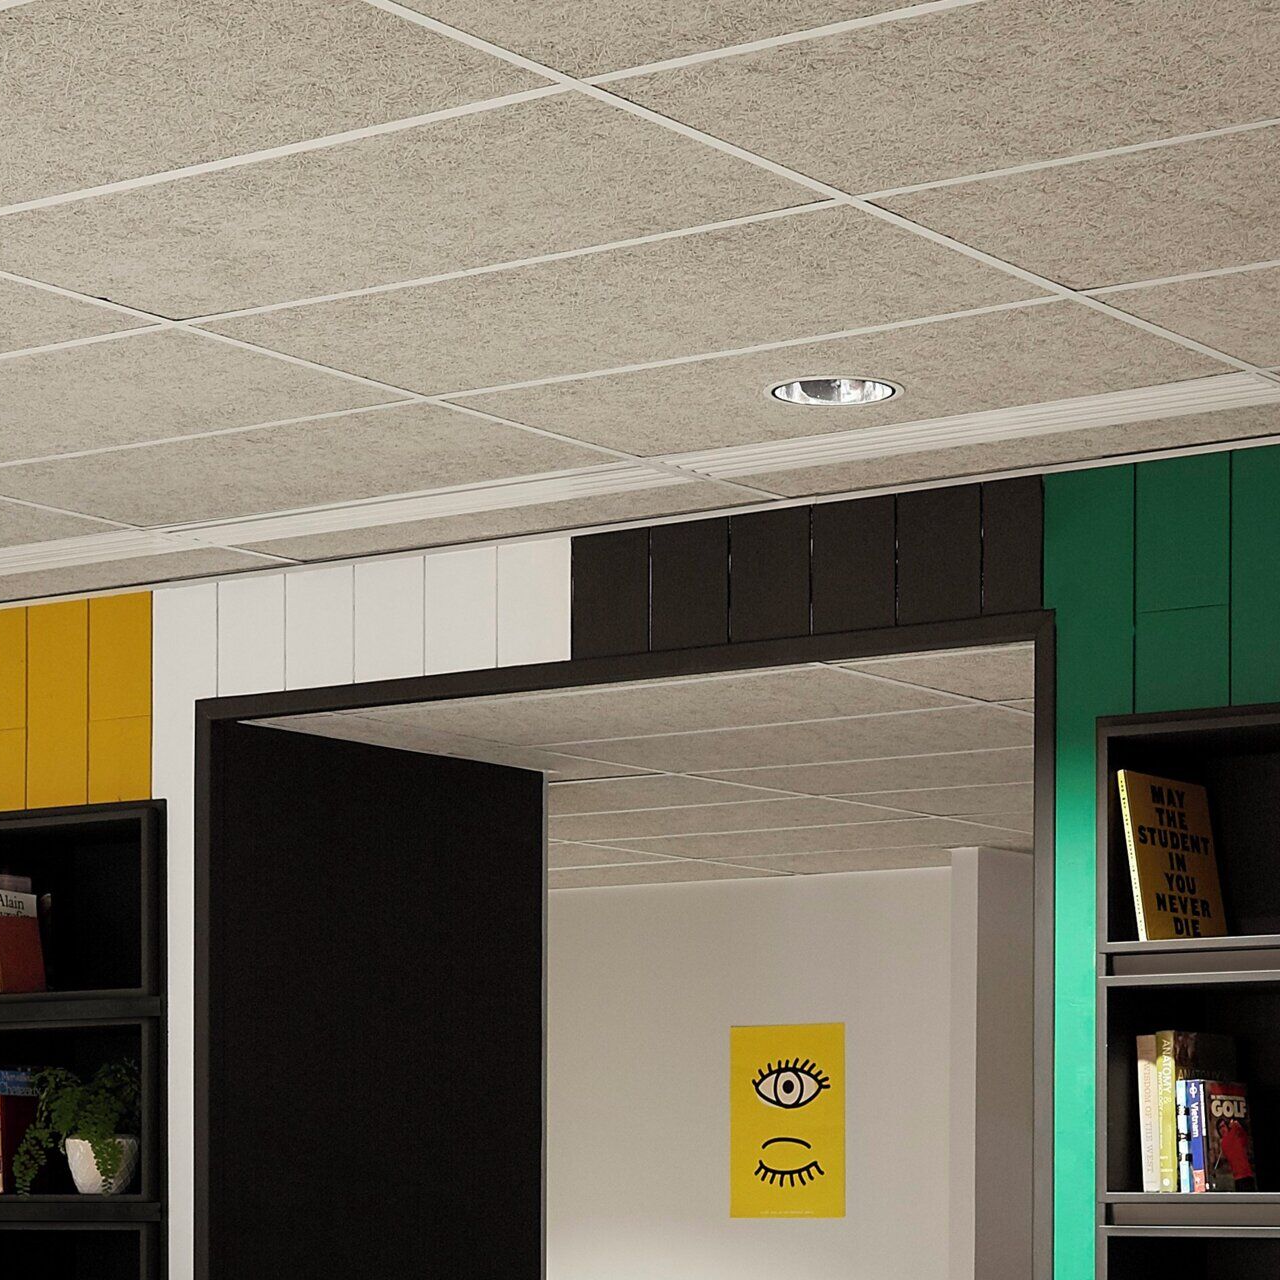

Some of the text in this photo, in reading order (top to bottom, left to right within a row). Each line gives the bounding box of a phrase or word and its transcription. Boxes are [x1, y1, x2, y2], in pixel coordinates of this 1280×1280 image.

[1150, 785, 1186, 809] MAY
[1155, 807, 1188, 831] THE
[1137, 825, 1210, 856] STUDENT
[1169, 852, 1187, 872] IN
[1164, 872, 1196, 895] YOU
[1156, 893, 1212, 918] NEVER
[1173, 917, 1202, 937] DIE
[1161, 1039, 1172, 1093] ANATOMY
[1190, 1102, 1199, 1138] Vietnam
[1210, 1099, 1247, 1118] GOLF
